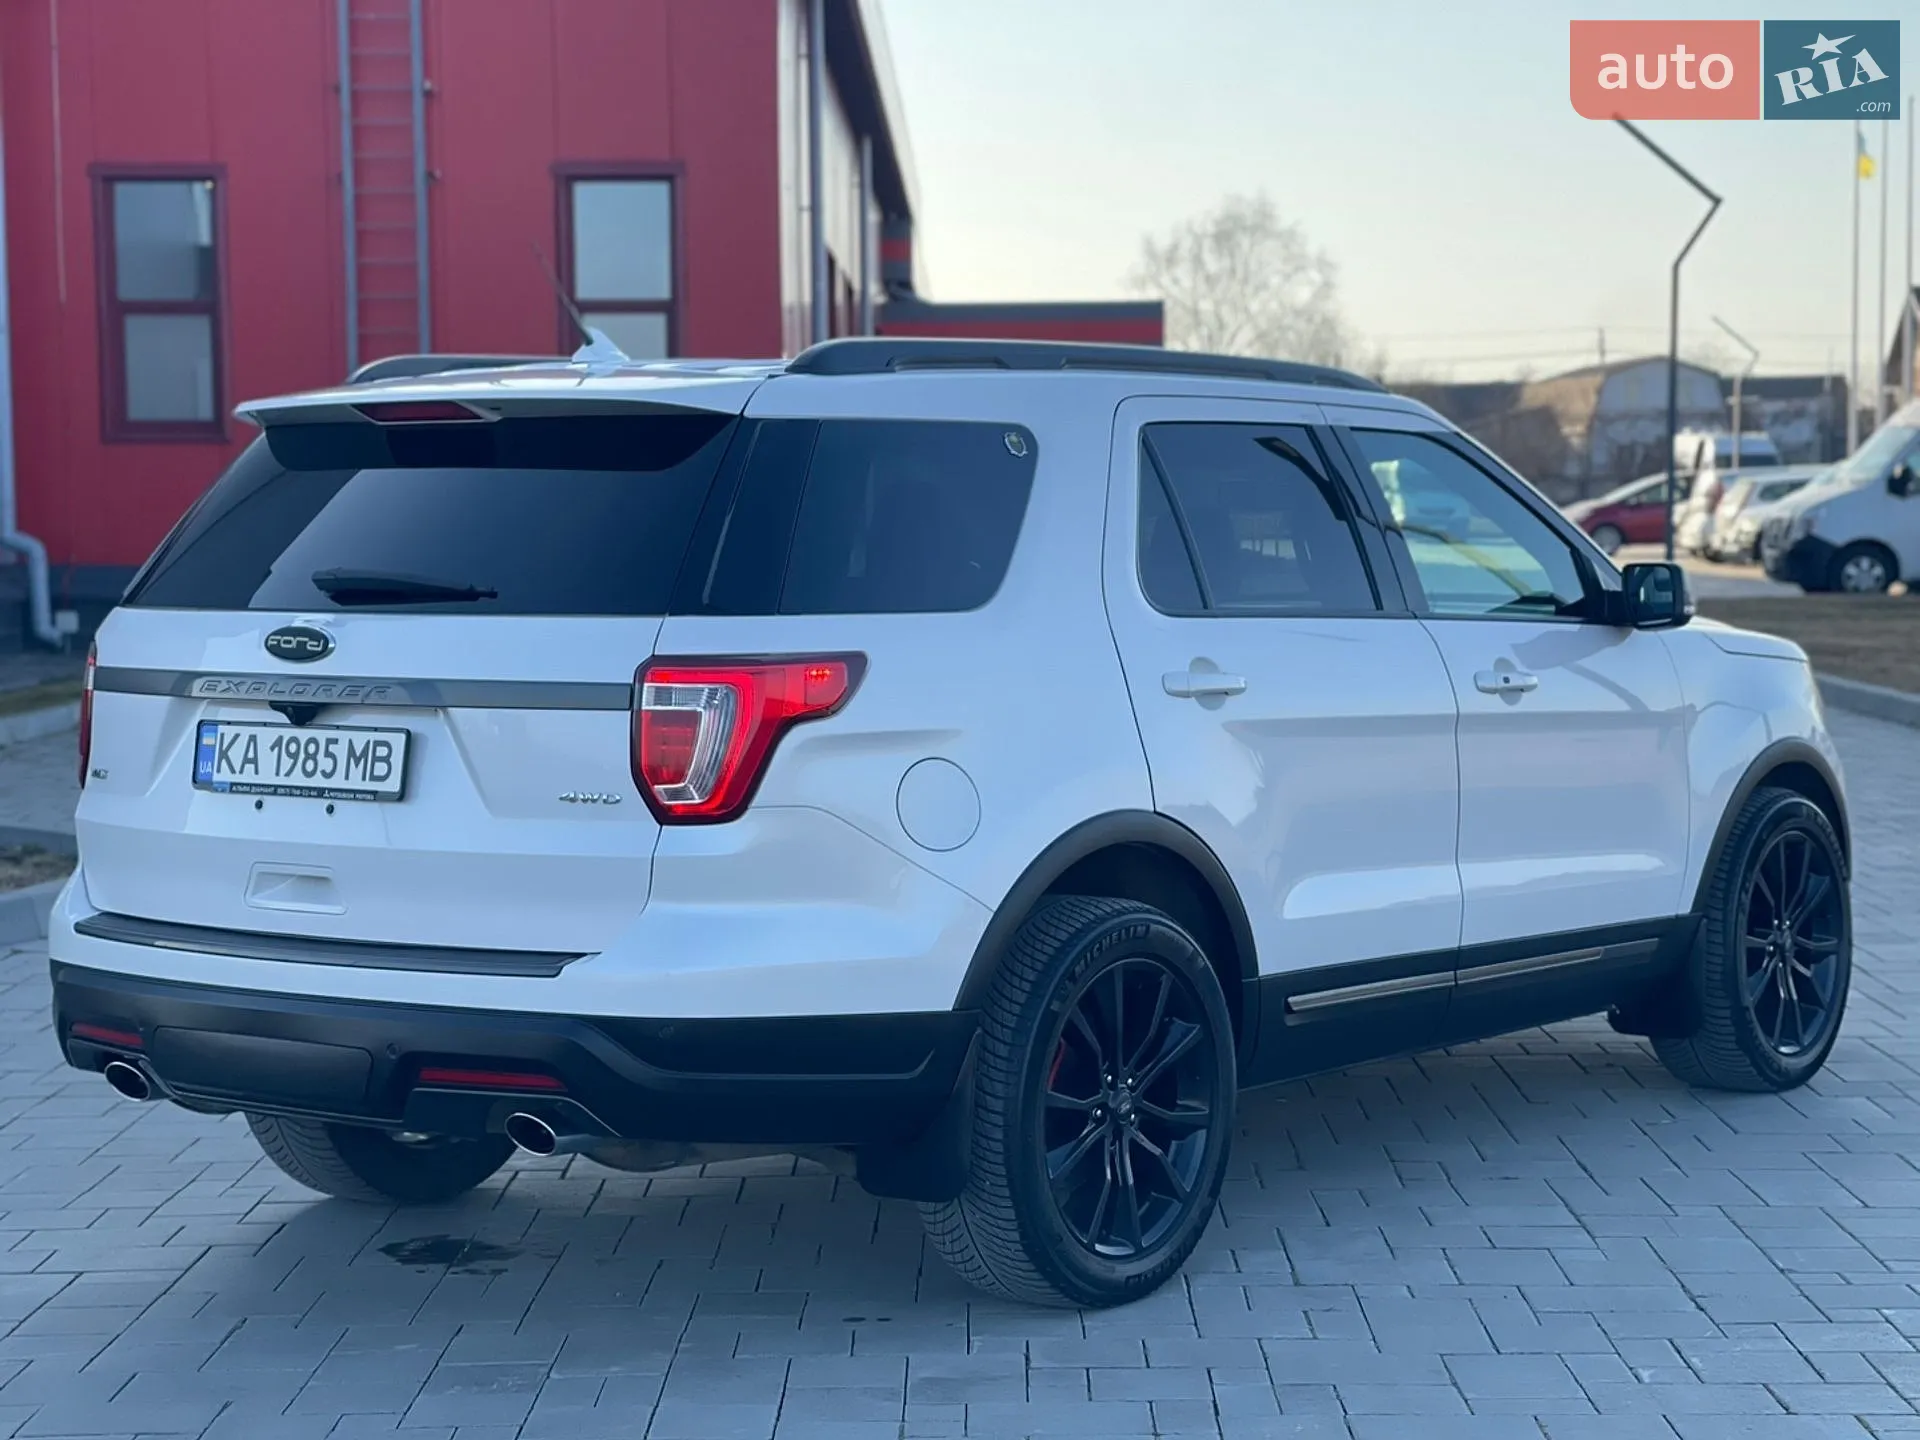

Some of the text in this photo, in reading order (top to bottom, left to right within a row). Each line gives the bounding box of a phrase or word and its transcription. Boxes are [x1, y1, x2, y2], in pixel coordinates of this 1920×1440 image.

[200, 679, 393, 700] EXPLORER
[200, 760, 213, 774] UA
[216, 732, 393, 783] KA 1985 MB
[559, 791, 623, 804] 4WD
[1074, 923, 1149, 978] MICHELIN
